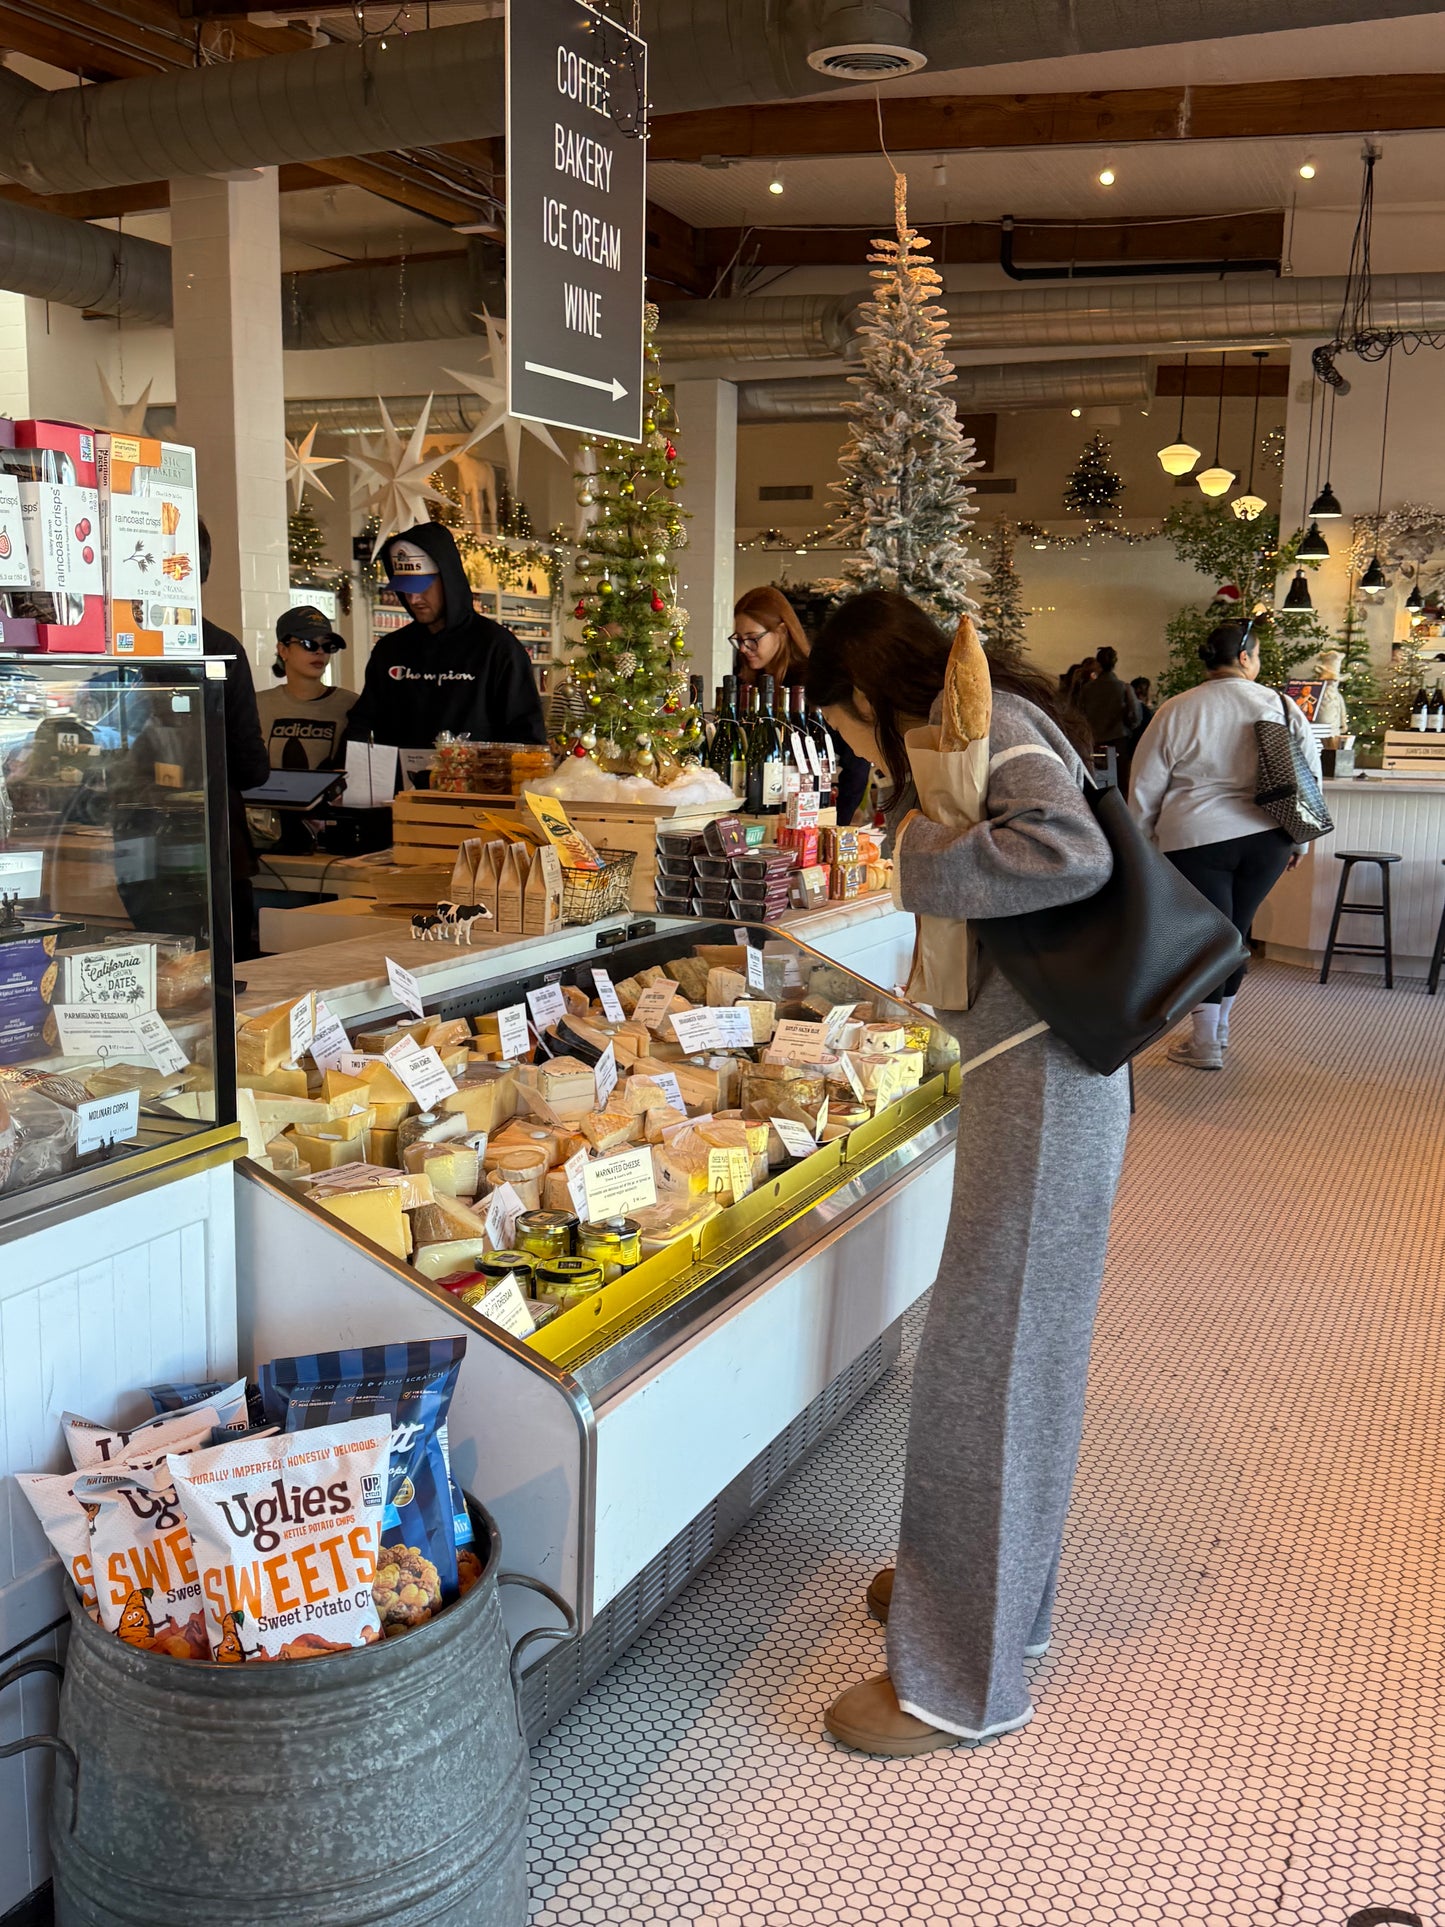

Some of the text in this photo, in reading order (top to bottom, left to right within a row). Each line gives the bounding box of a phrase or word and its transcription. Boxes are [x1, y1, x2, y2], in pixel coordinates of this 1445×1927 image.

[557, 45, 611, 118] COFFEE
[554, 123, 613, 193] BAKERY
[543, 196, 621, 272] ICE CREAM
[564, 282, 602, 339] WINE
[22, 502, 38, 514] isps
[52, 488, 65, 588] raincoast crisps
[273, 722, 334, 738] adidas
[88, 956, 142, 982] California
[108, 976, 136, 990] DATES
[88, 1102, 128, 1120] MOLINARI COPPA
[595, 1164, 622, 1178] MARINATED
[622, 1159, 640, 1170] CHEESE
[406, 1372, 444, 1382] SCRATCH
[183, 1392, 208, 1401] BATCH
[288, 1449, 330, 1468] HONESTLY
[215, 1478, 349, 1552] Uglies
[283, 1515, 356, 1540] KETTLE POTATO CHIPS
[108, 1526, 200, 1605] SWE
[258, 1609, 301, 1632] Sweet
[304, 1597, 351, 1621] Potato
